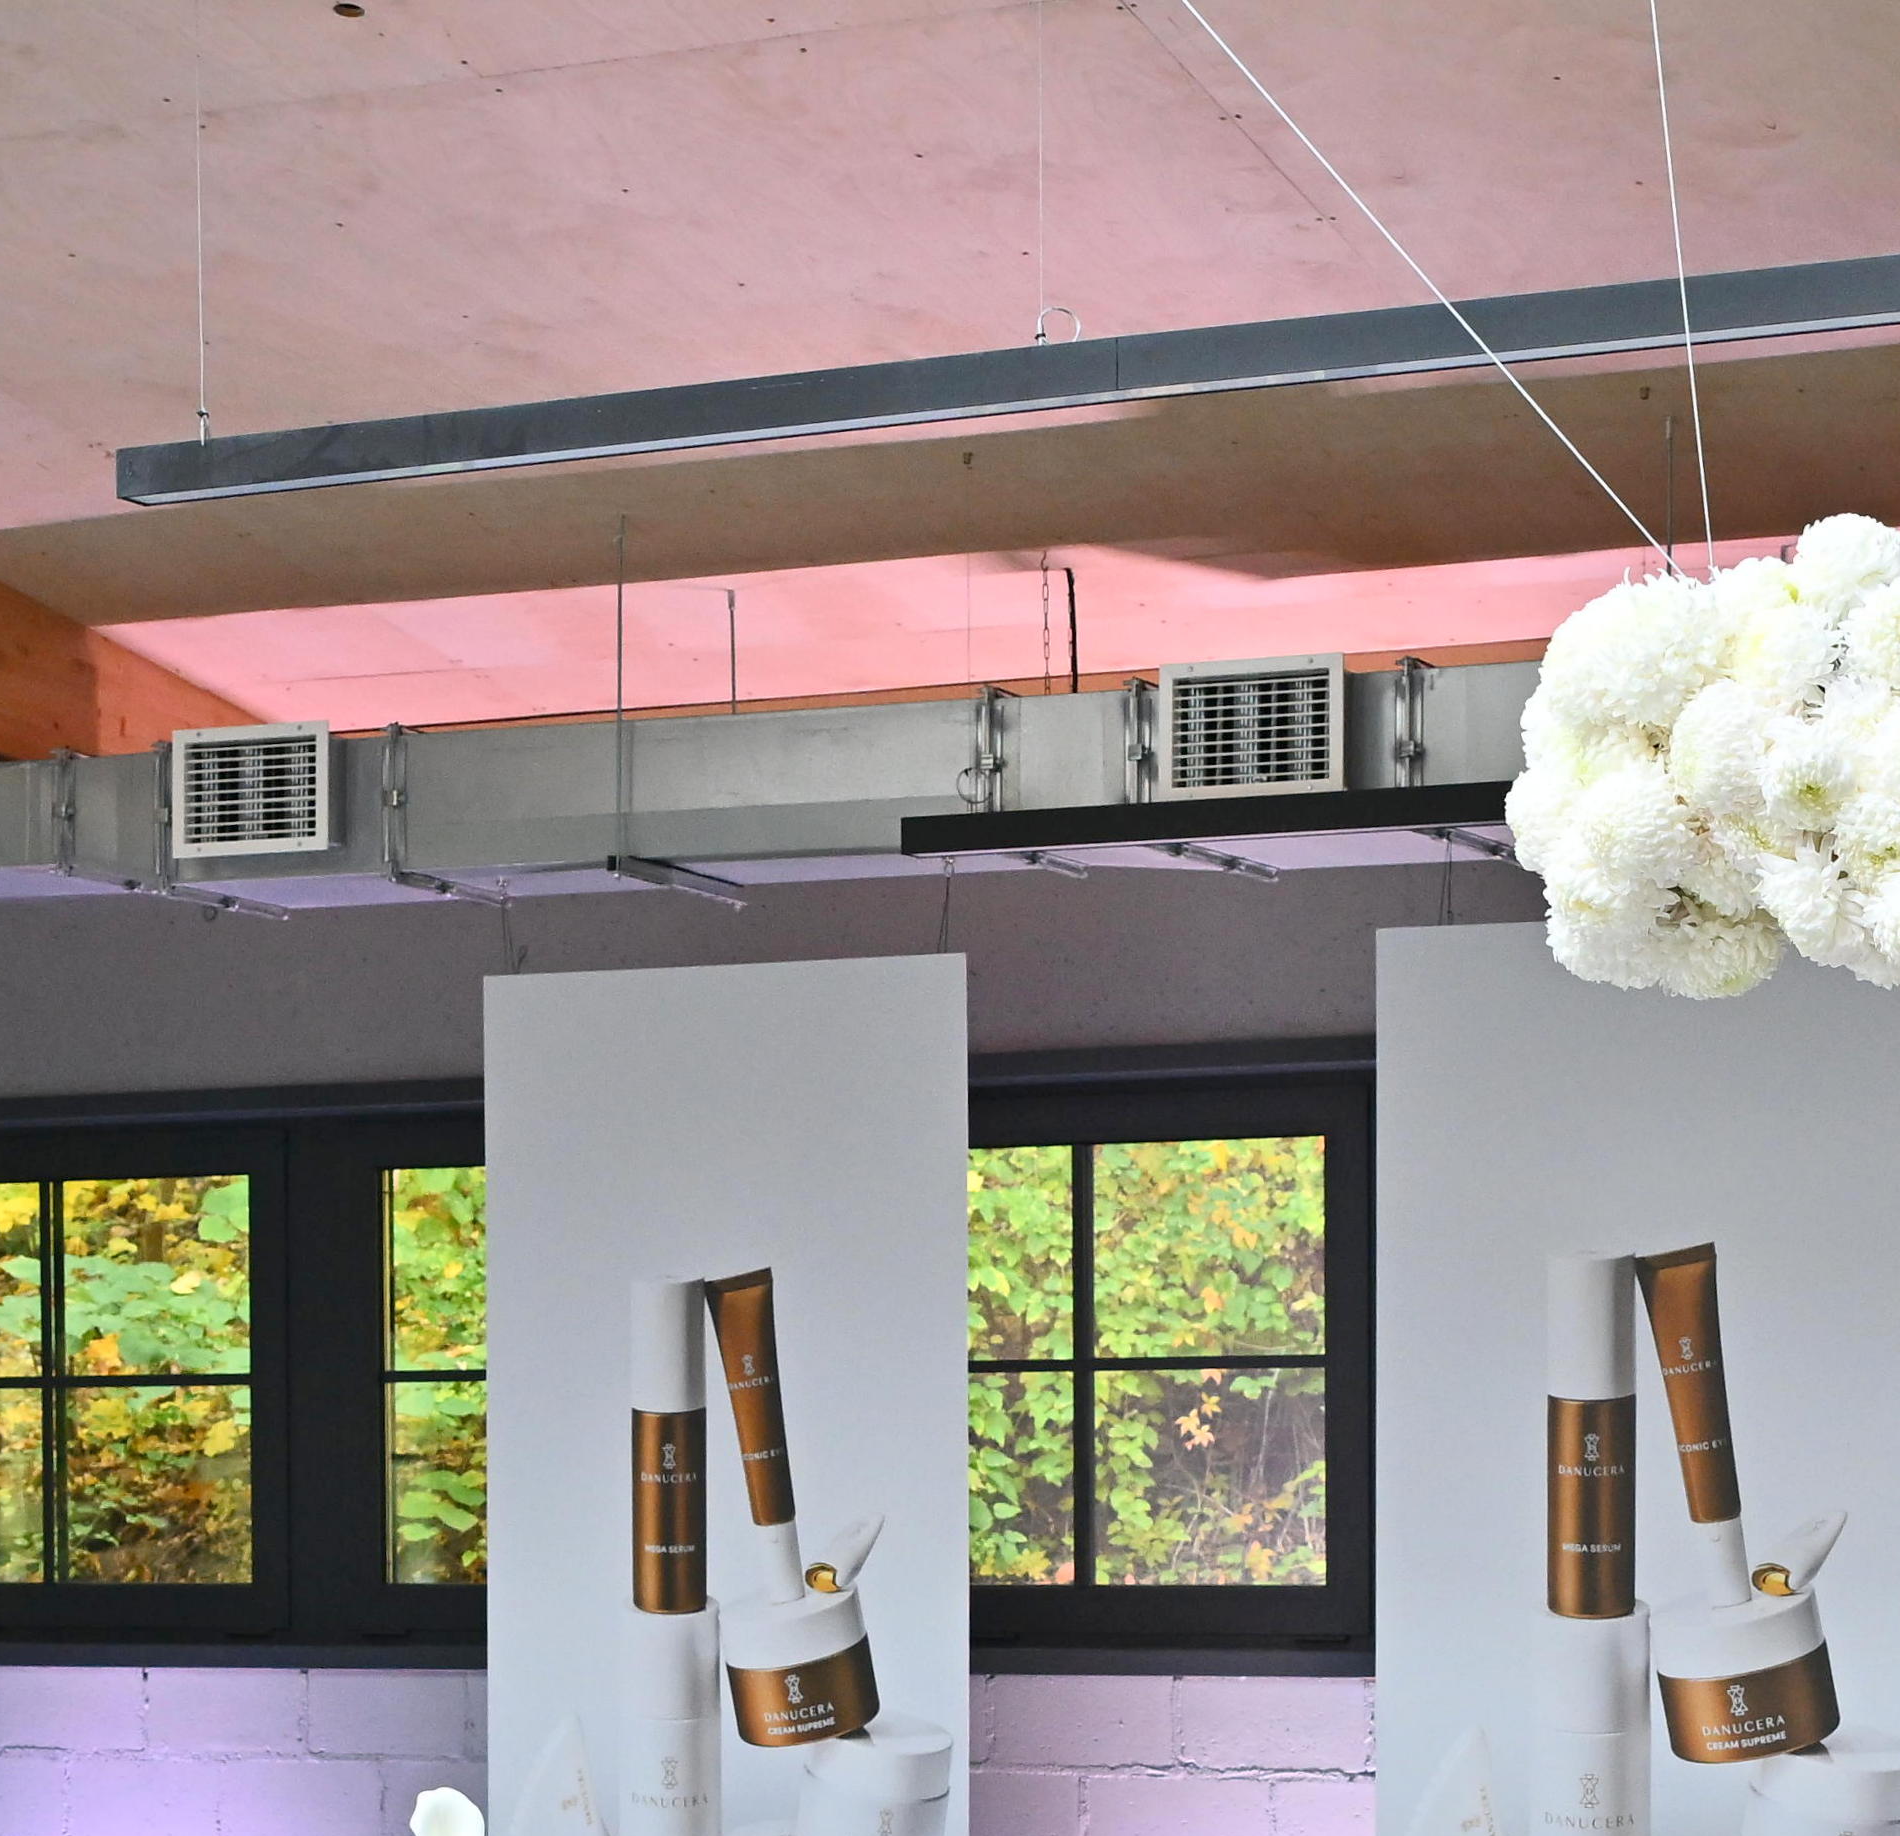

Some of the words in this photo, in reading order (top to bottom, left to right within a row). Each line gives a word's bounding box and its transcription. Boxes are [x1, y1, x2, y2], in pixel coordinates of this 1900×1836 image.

[641, 1472, 697, 1484] DANUCERA
[1558, 1464, 1625, 1477] DANUCERA
[1590, 1543, 1621, 1554] SERUM
[764, 1701, 835, 1722] DANUCERA
[767, 1725, 796, 1736] CREAM
[797, 1717, 836, 1733] SUPREME
[1701, 1714, 1786, 1737] DANUCERA
[1706, 1739, 1740, 1751] CREAM
[1741, 1731, 1787, 1748] SUPREME
[631, 1792, 709, 1808] DANUCERA
[1544, 1811, 1635, 1830] DANUCERA
